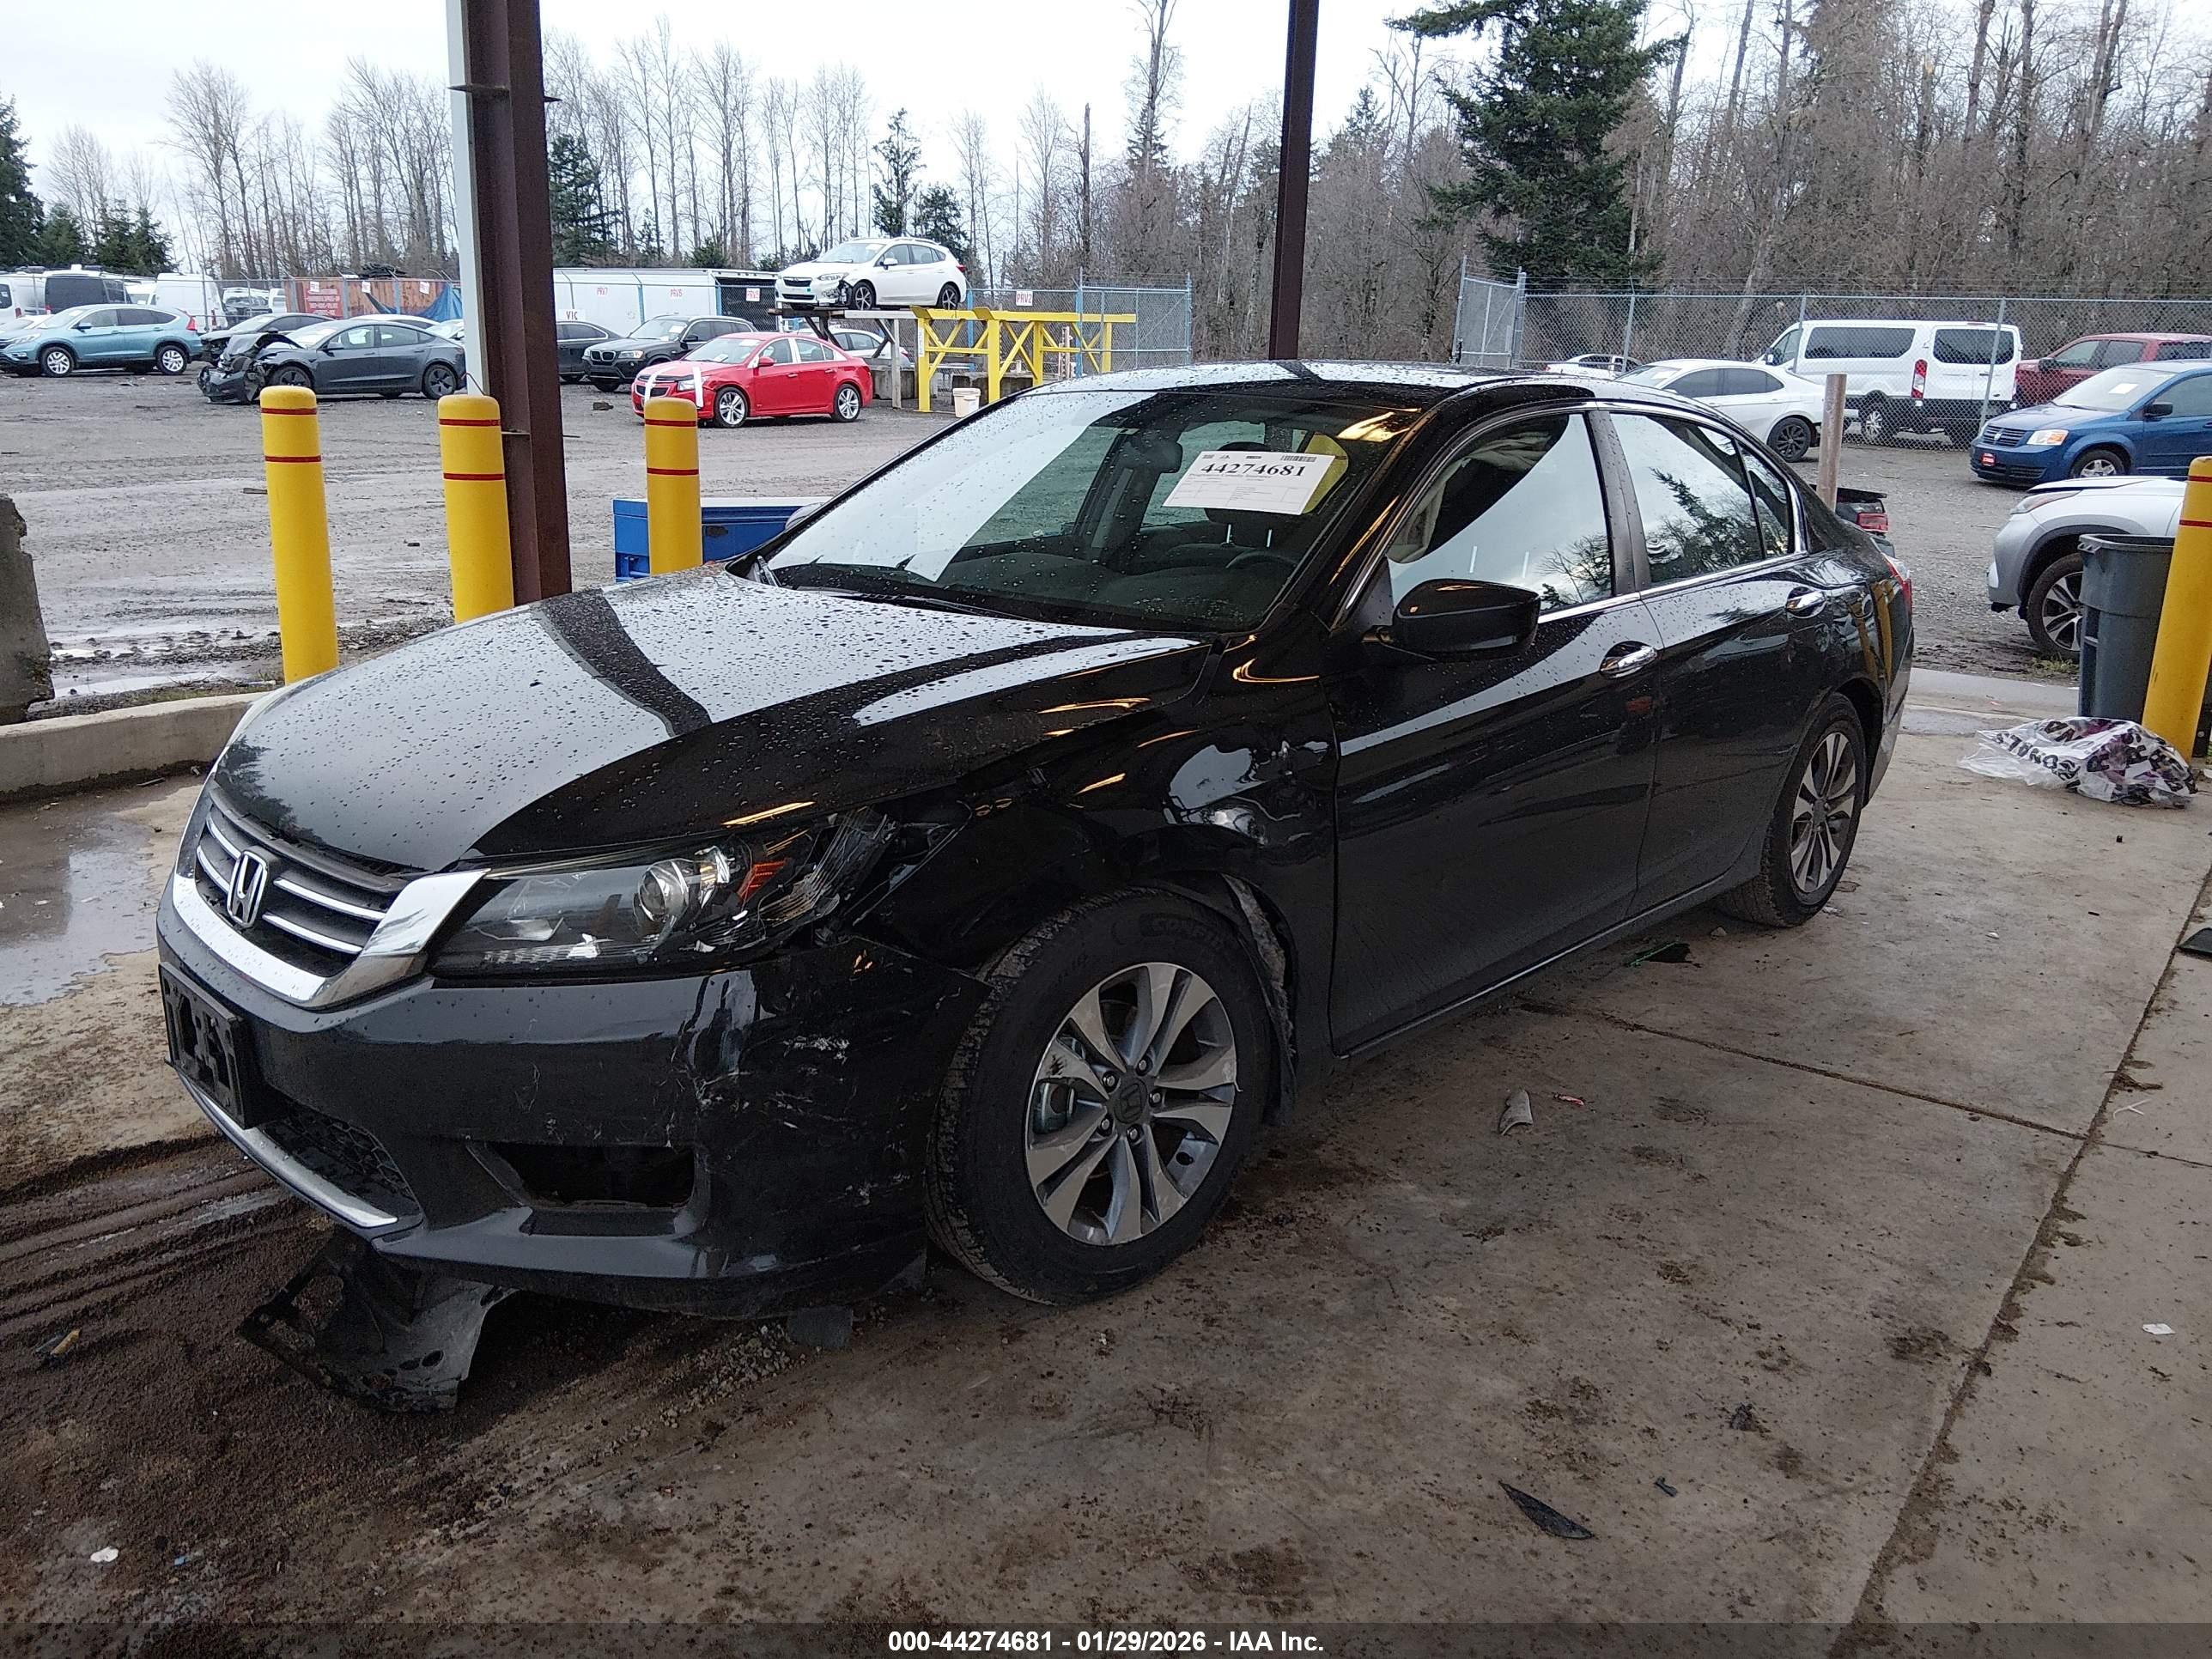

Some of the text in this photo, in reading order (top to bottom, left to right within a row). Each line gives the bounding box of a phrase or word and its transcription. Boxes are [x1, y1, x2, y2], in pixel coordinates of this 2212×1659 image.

[1017, 293, 1032, 304] PRV2
[566, 311, 578, 320] VIC
[1200, 463, 1306, 477] 44274681
